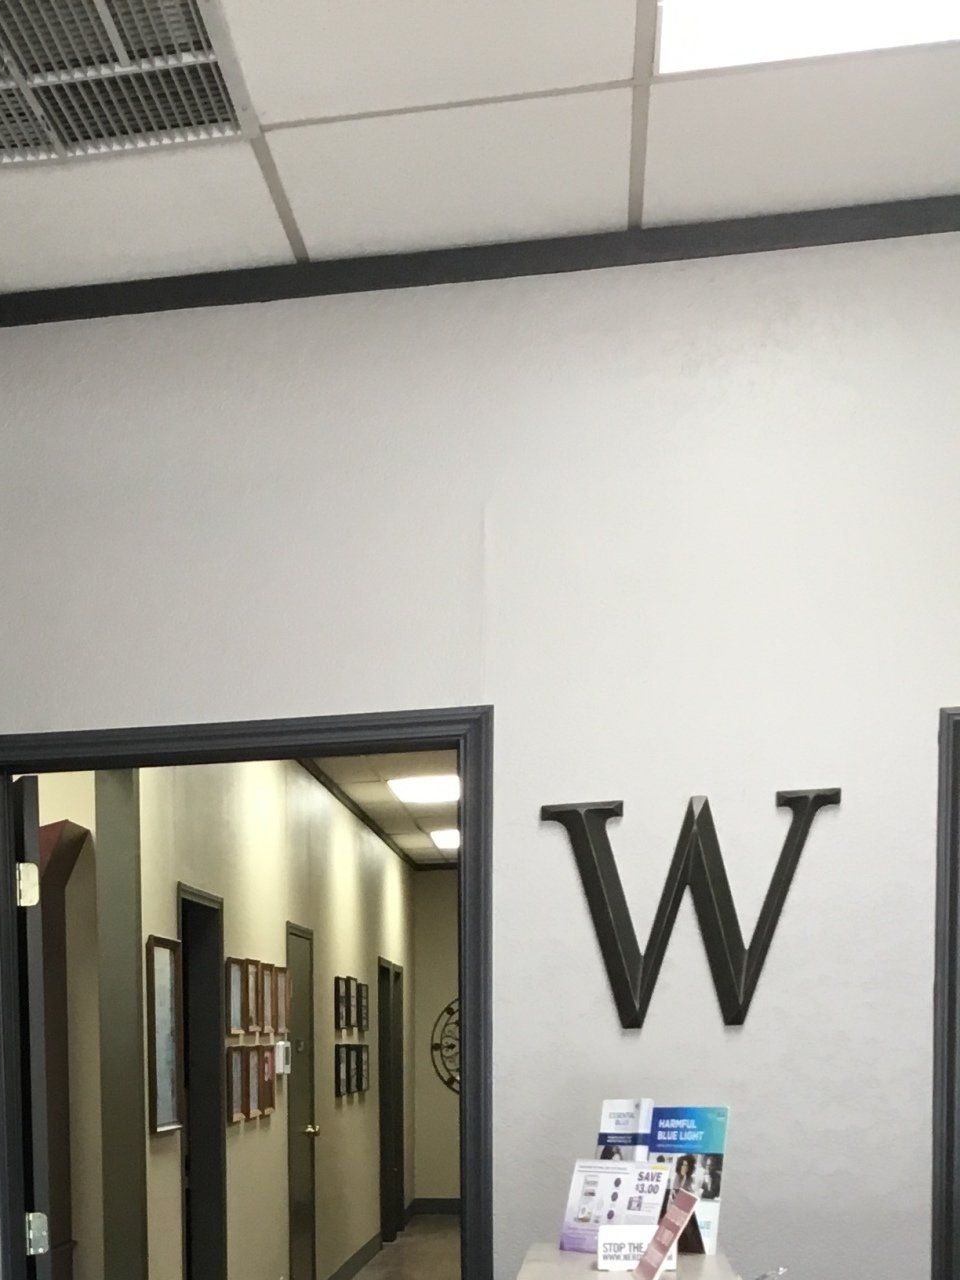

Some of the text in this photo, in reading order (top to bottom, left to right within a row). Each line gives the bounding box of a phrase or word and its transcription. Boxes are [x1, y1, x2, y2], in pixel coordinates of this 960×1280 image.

[539, 787, 843, 1029] W
[658, 1118, 697, 1129] HARMFUL
[657, 1130, 704, 1141] BLUE LIGHT
[637, 1171, 663, 1183] SAVE
[635, 1183, 660, 1195] $3.00
[602, 1242, 645, 1254] STOP THE
